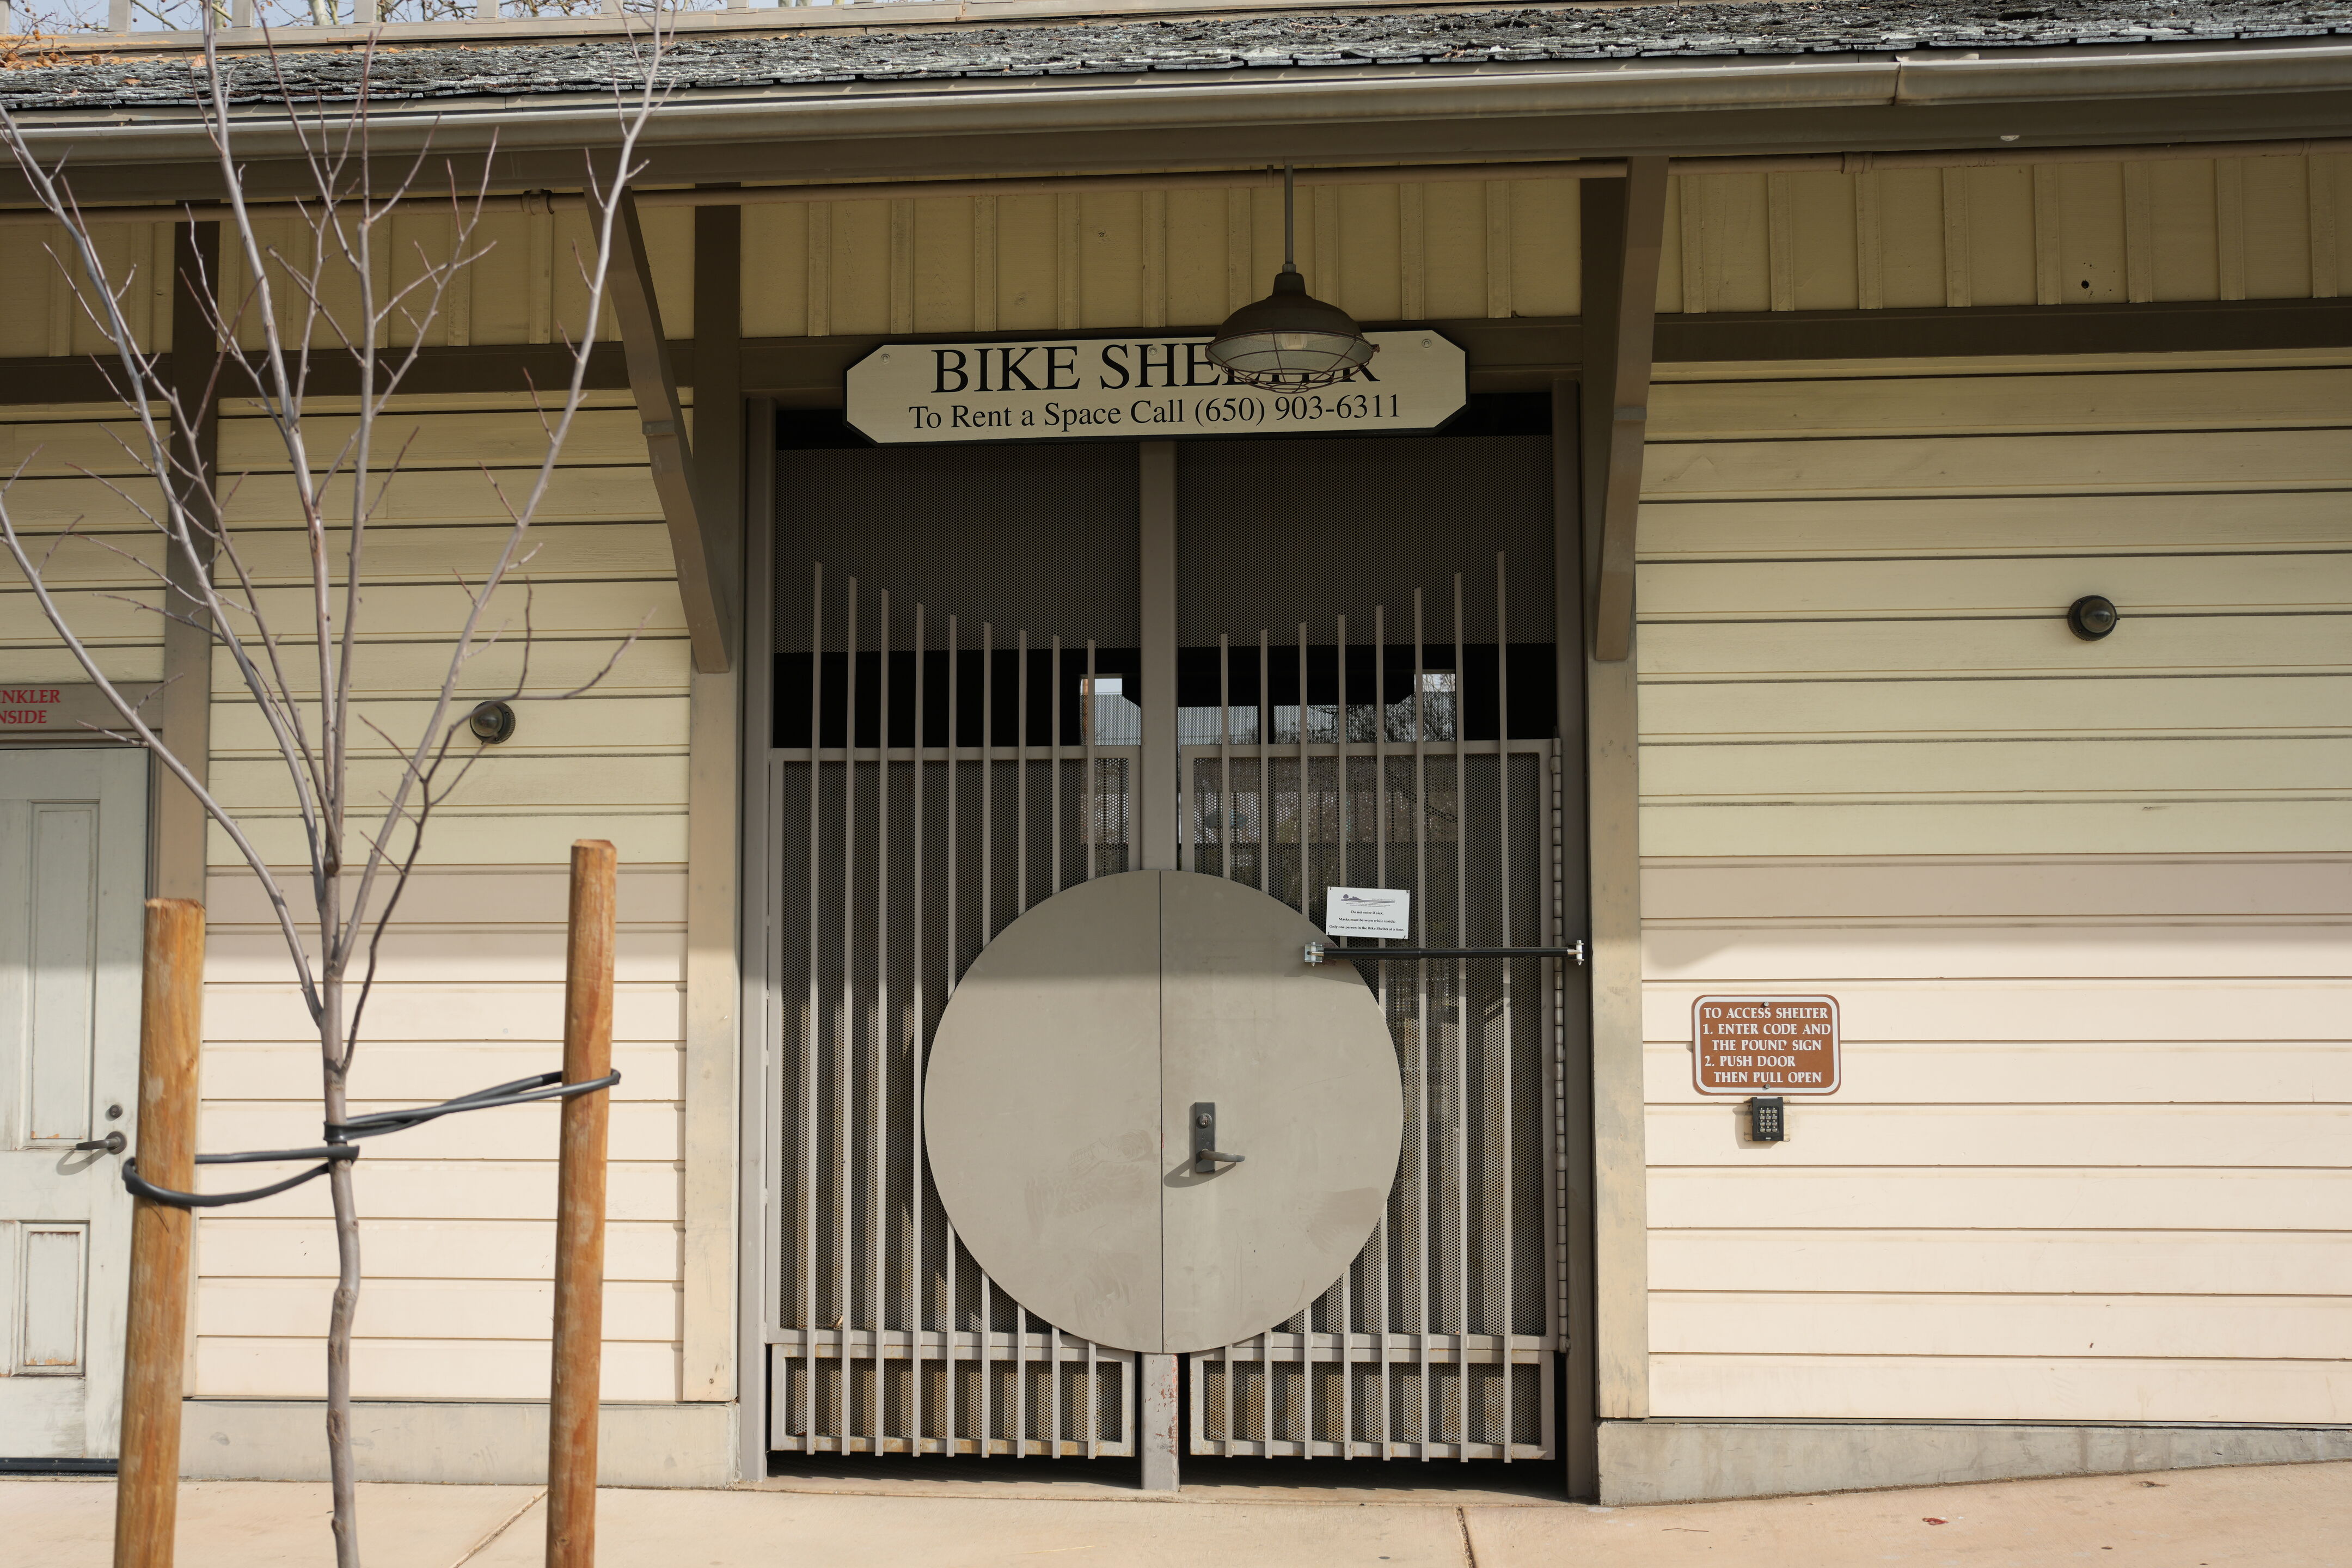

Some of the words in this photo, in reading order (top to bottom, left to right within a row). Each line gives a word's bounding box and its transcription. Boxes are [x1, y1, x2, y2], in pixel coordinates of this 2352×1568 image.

[930, 346, 1081, 393] BIKE
[909, 406, 941, 429] To
[951, 405, 1012, 428] Rent
[1021, 409, 1035, 426] a
[1044, 402, 1122, 432] Space
[1130, 399, 1185, 424] Call
[1195, 397, 1265, 427] (650)
[1275, 394, 1400, 421] 903-6311
[0, 689, 61, 703] NKLER
[1704, 1007, 1722, 1019] TO
[1726, 1007, 1771, 1019] ACCESS
[1776, 1007, 1828, 1019] SHELTER
[1703, 1024, 1713, 1034] 1.
[1718, 1024, 1759, 1034] ENTER
[1763, 1024, 1797, 1035] CODE
[1802, 1024, 1831, 1035] AND
[1712, 1040, 1736, 1051] THE
[1741, 1040, 1787, 1051] POUND
[1792, 1040, 1822, 1051] SIGN
[1705, 1056, 1714, 1067] 2.
[1720, 1056, 1752, 1067] PUSH
[1757, 1056, 1796, 1067] DOOR
[1714, 1072, 1748, 1083] THEN
[1753, 1072, 1783, 1083] PULL
[1788, 1072, 1822, 1083] OPEN
